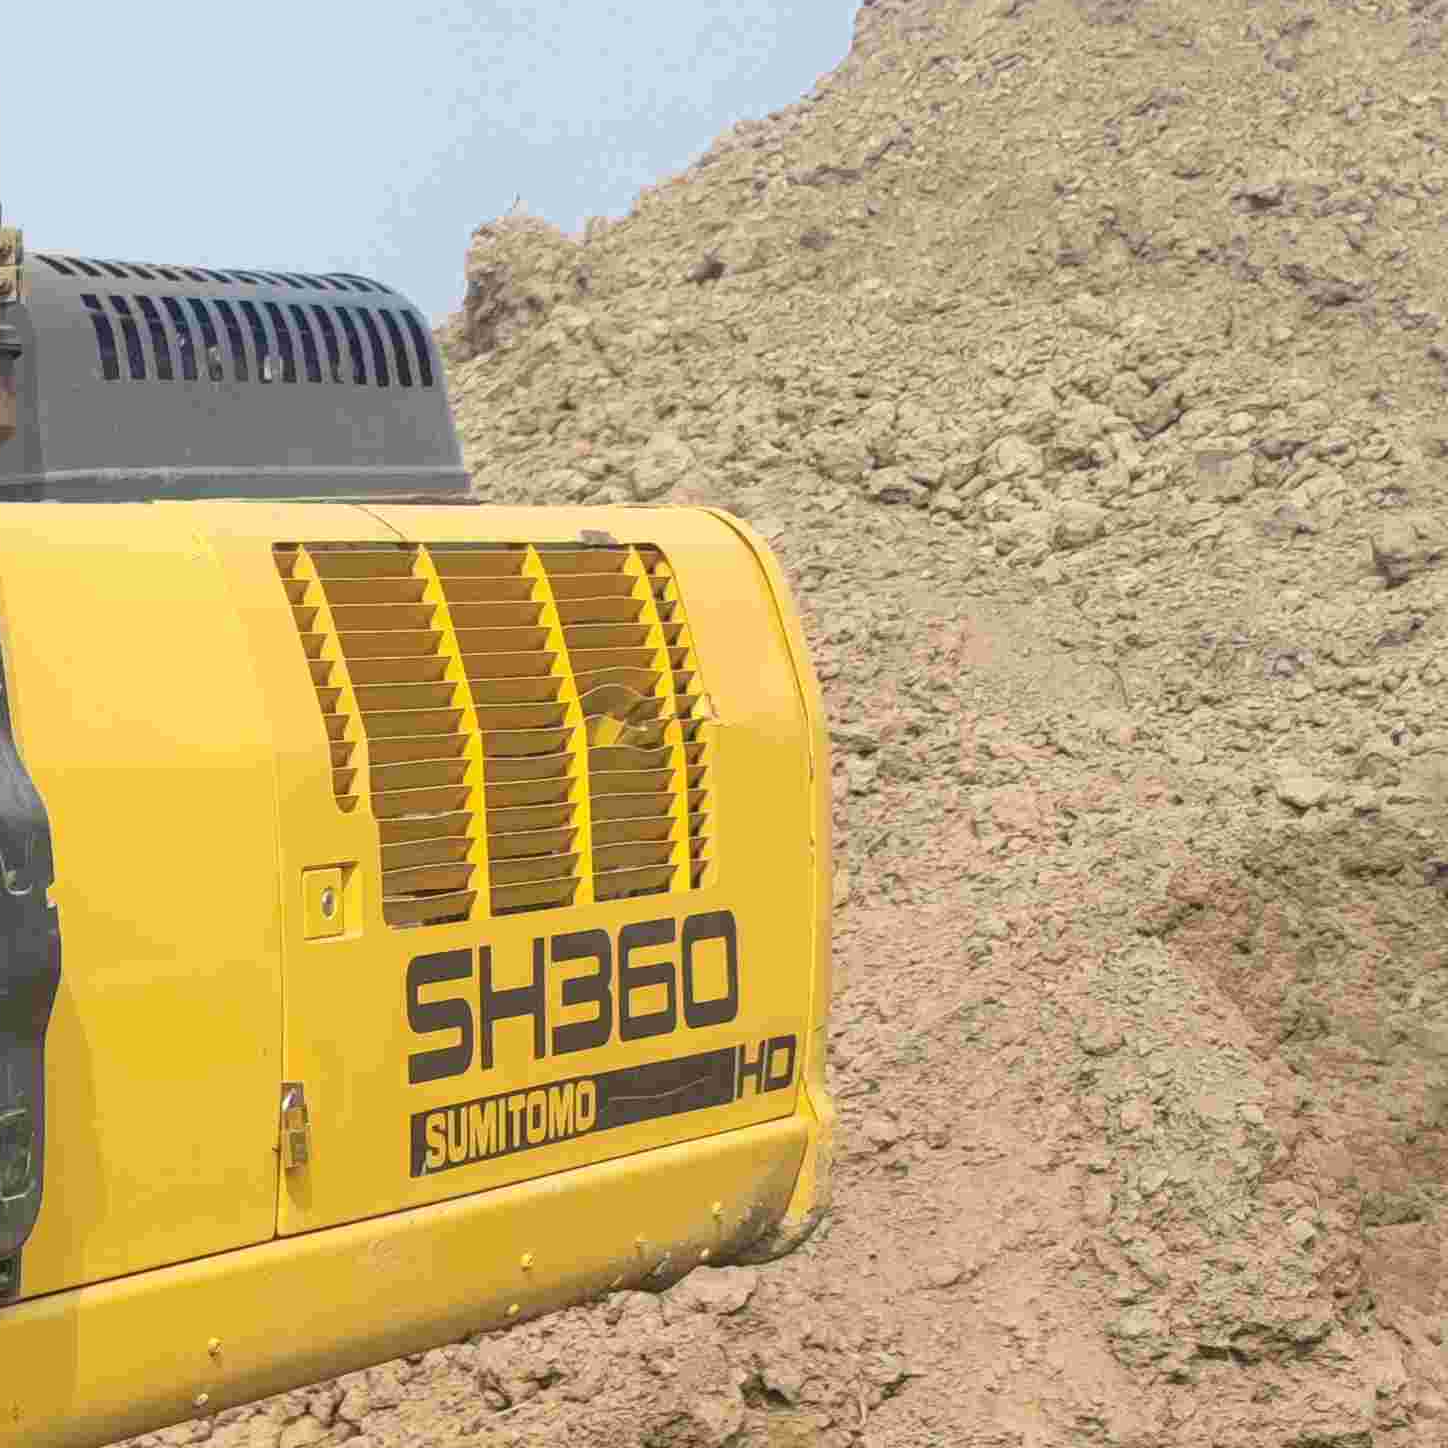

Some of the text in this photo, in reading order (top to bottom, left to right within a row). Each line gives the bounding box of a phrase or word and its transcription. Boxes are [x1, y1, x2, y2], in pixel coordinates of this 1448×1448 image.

[405, 908, 739, 1085] SH360
[423, 1033, 797, 1170] SUMITOMO HD
